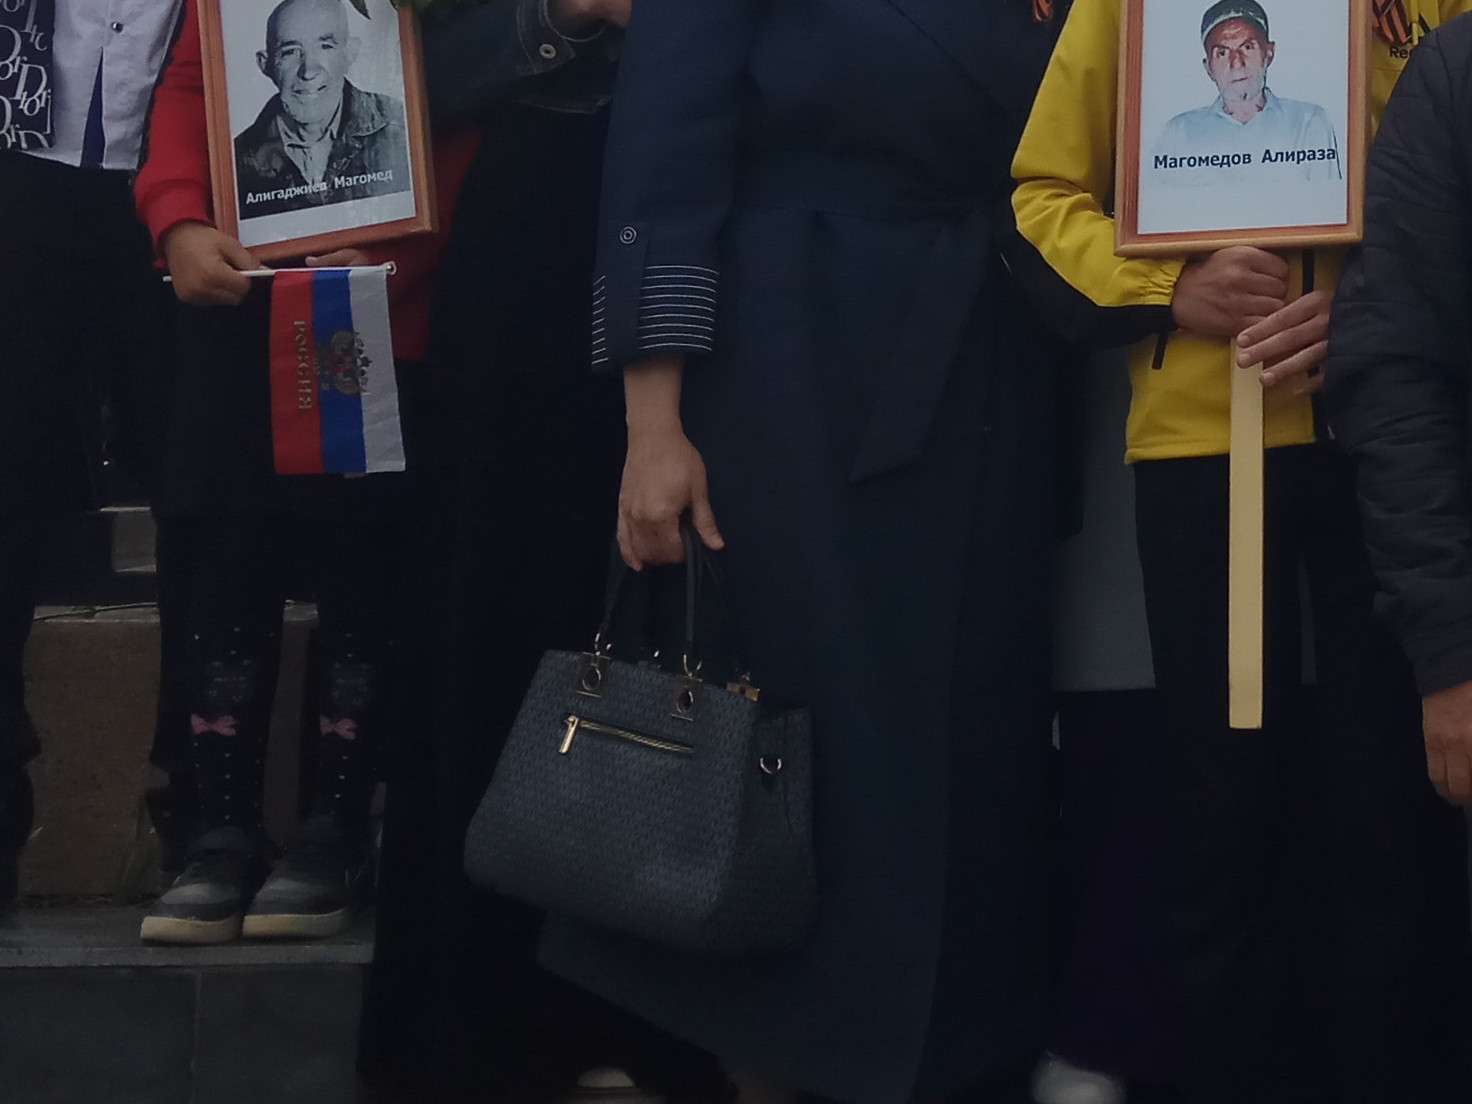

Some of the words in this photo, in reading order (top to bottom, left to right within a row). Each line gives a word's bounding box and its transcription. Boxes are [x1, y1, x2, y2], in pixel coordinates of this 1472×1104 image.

[1153, 151, 1252, 169] Магомедов
[1261, 147, 1336, 164] Алираза
[245, 181, 328, 205] Алигаджиев
[334, 168, 394, 189] Магомед
